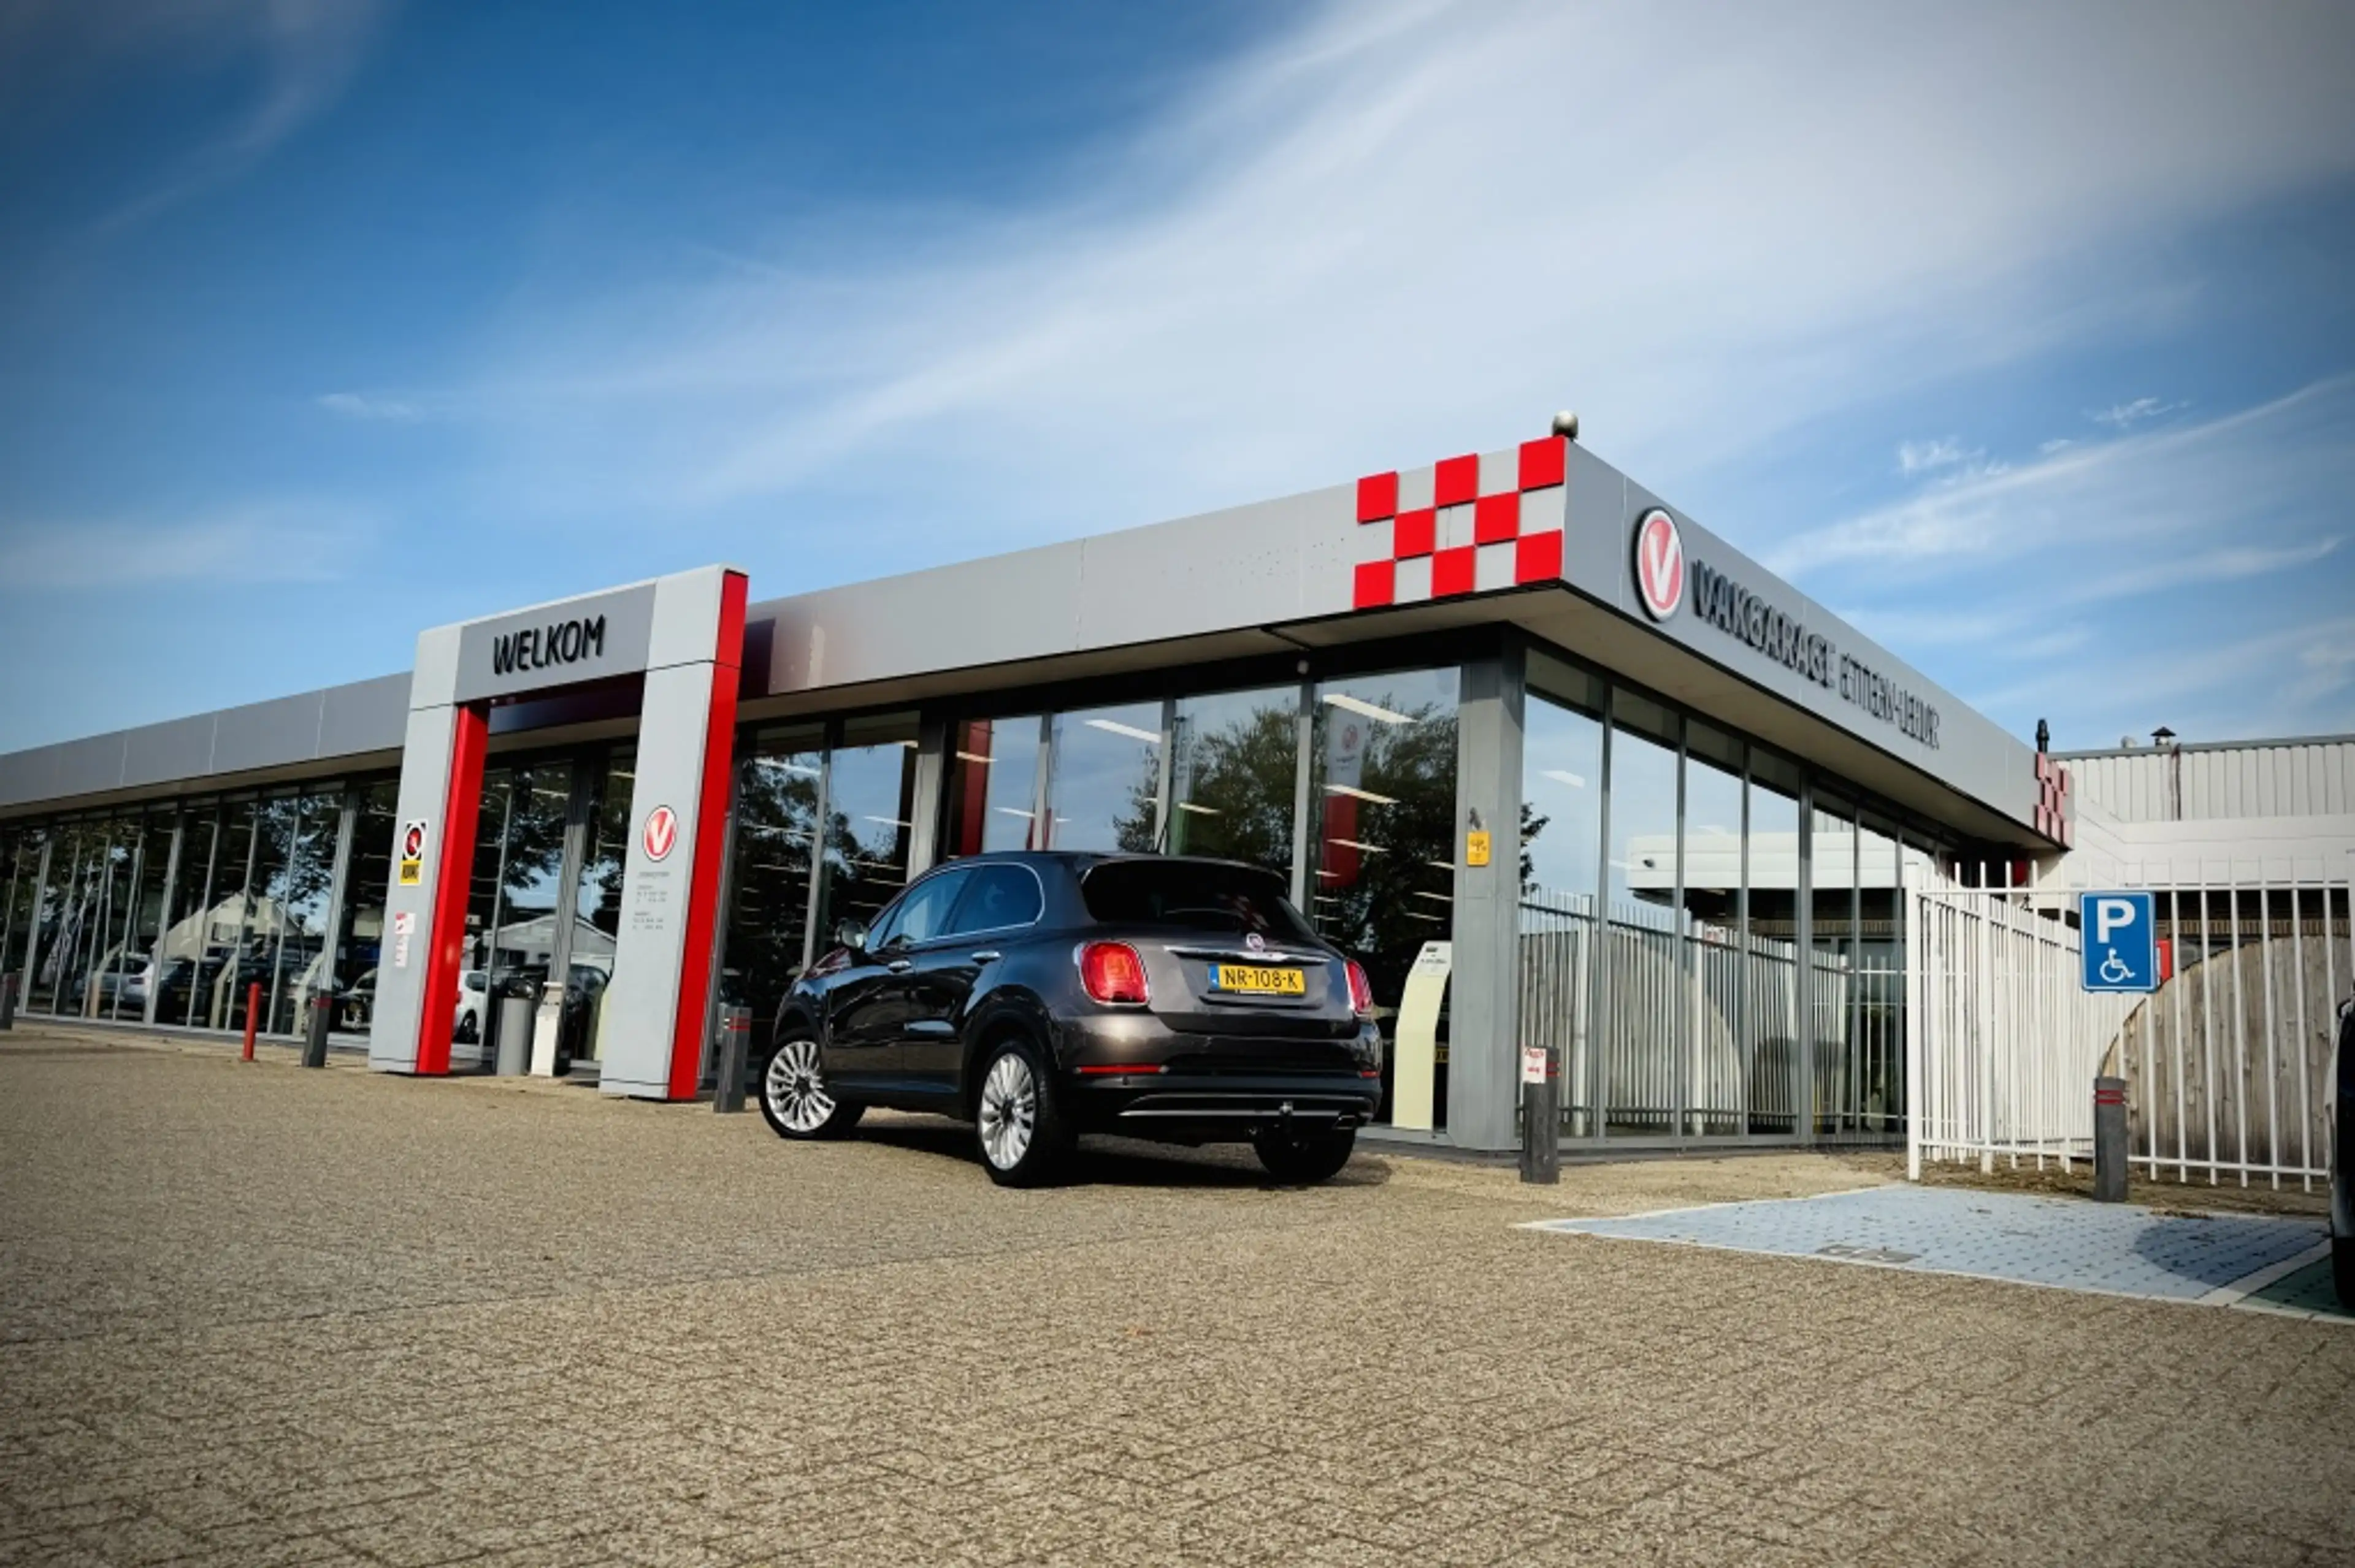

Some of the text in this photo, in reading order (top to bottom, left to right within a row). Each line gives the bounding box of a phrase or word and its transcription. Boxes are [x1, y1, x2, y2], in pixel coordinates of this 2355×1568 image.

[494, 613, 606, 676] WELKOM
[1691, 559, 1940, 751] VAKGARAGE ETTEN-LEUR
[2097, 899, 2135, 944] P
[1225, 968, 1298, 989] NR-108-K
